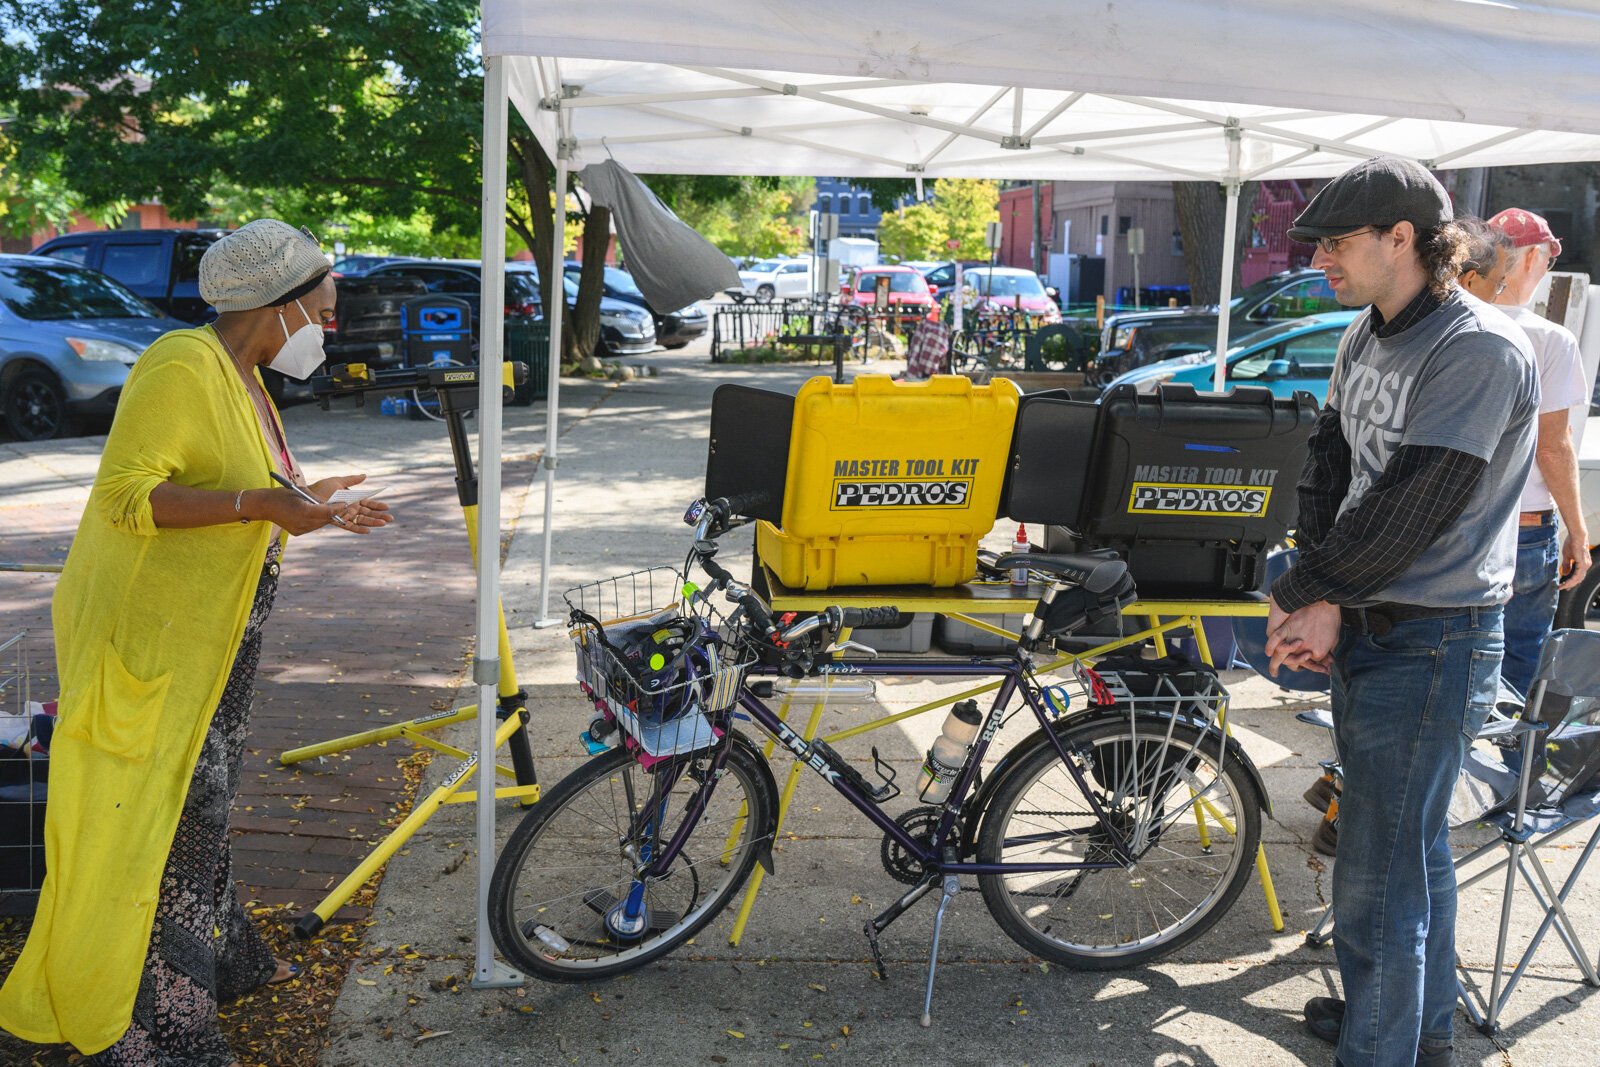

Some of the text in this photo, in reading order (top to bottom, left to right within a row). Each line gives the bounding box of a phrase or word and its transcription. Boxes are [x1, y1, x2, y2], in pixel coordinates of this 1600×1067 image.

[1342, 361, 1414, 429] YPSI
[833, 459, 979, 477] MASTER TOOL KIT
[1133, 465, 1279, 486] MASTER TOOL KIT
[837, 480, 968, 505] PEDRO'S
[1134, 487, 1267, 513] PEDRO'S
[982, 709, 1004, 742] 850
[778, 722, 841, 785] TREK
